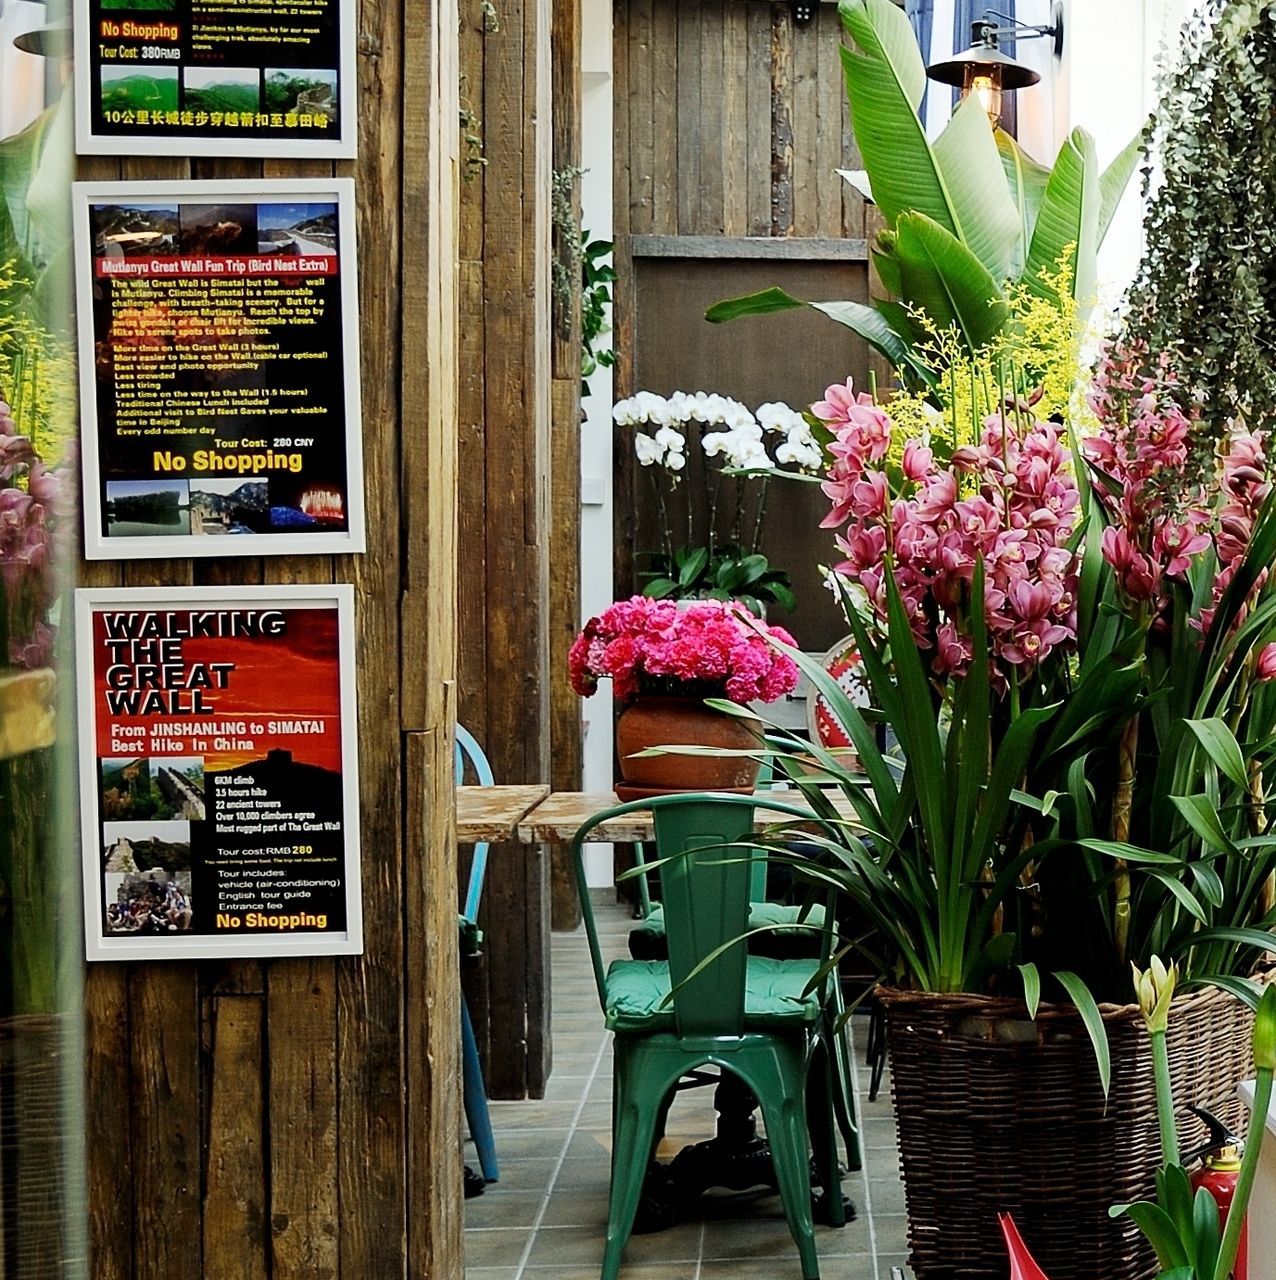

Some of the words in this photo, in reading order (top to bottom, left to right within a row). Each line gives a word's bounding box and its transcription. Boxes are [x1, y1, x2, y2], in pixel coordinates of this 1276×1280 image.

[103, 22, 119, 36] No
[123, 23, 177, 40] Shopping
[102, 260, 148, 275] Mutianyu
[151, 261, 179, 272] Great
[181, 260, 203, 272] Wall
[205, 260, 223, 272] Fun
[226, 260, 246, 274] Trip
[249, 260, 272, 272] (Bird
[299, 259, 328, 271] Extra)
[112, 280, 128, 288] The
[211, 279, 244, 287] Simatai
[169, 289, 208, 298] Climbing
[182, 299, 243, 307] breath-taking
[215, 439, 238, 448] Tour
[274, 438, 291, 447] 280
[154, 452, 186, 471] No
[193, 450, 302, 473] Shopping
[103, 612, 286, 637] WALKING
[105, 638, 183, 663] THE
[106, 664, 235, 688] GREAT
[105, 690, 214, 714] WALL
[112, 724, 145, 736] From
[150, 722, 246, 736] JINSHANLING
[250, 723, 264, 734] to
[268, 721, 324, 734] SIMATAI
[112, 739, 144, 752] Best
[151, 739, 184, 751] Hike
[214, 738, 254, 751] China
[251, 788, 267, 796] hike
[293, 846, 312, 854] 280
[256, 880, 340, 888] (air-conditioning)
[219, 892, 255, 900] English
[284, 891, 311, 899] guide
[217, 914, 240, 927] No
[246, 912, 326, 929] Shopping
